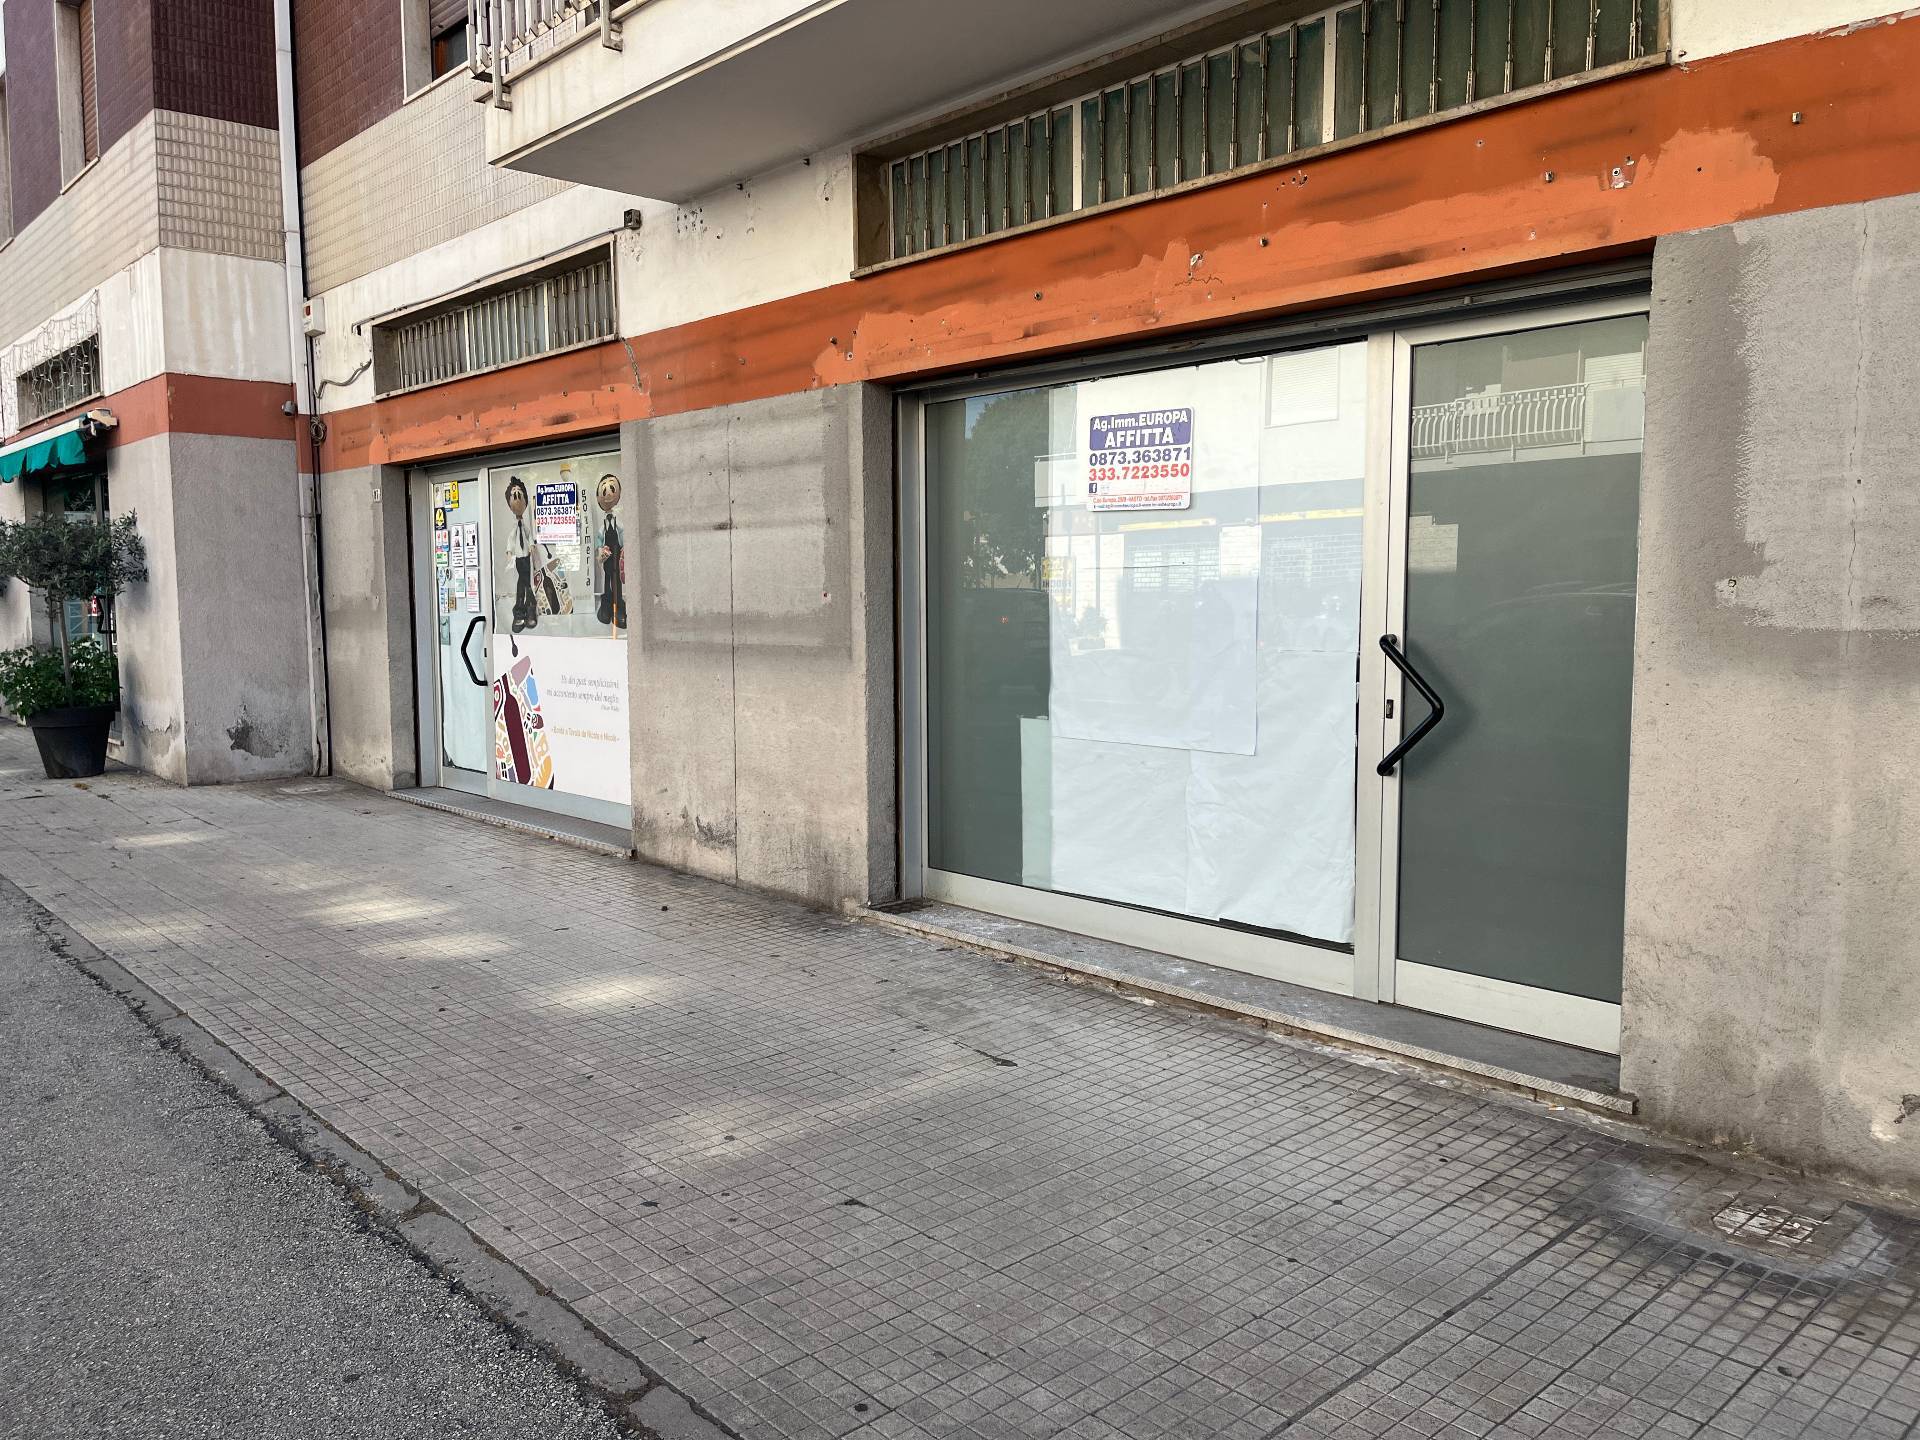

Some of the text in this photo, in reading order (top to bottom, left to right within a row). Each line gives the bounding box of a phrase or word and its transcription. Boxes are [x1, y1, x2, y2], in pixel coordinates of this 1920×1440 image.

[1104, 427, 1174, 448] AFFITTA
[1089, 447, 1191, 467] 0873.363871
[1089, 463, 1190, 482] 333.7223550
[542, 494, 570, 505] AFFITTA
